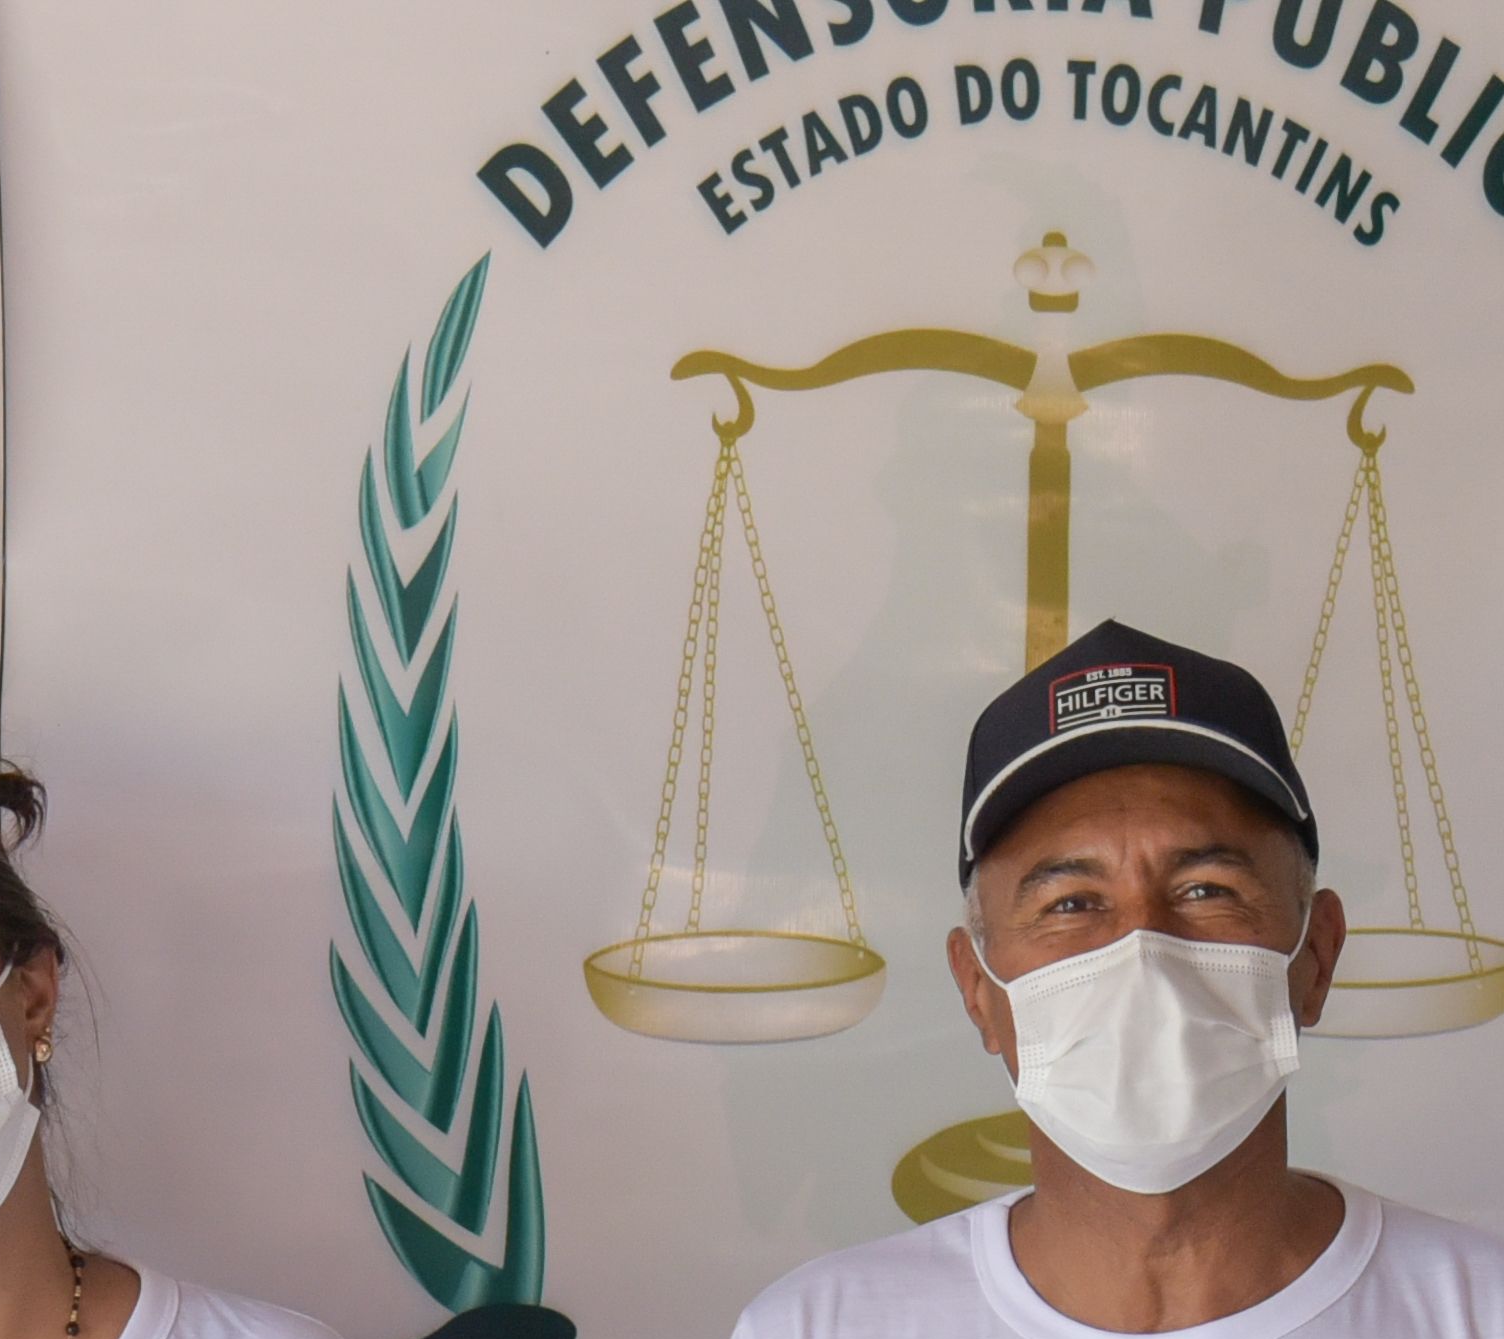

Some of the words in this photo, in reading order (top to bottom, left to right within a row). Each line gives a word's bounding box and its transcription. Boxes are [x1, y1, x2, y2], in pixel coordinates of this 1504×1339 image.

[696, 76, 929, 235] ESTADO
[954, 58, 1040, 126] DO
[1067, 60, 1400, 246] TOCANTINS
[1057, 683, 1165, 715] HILFIGER
